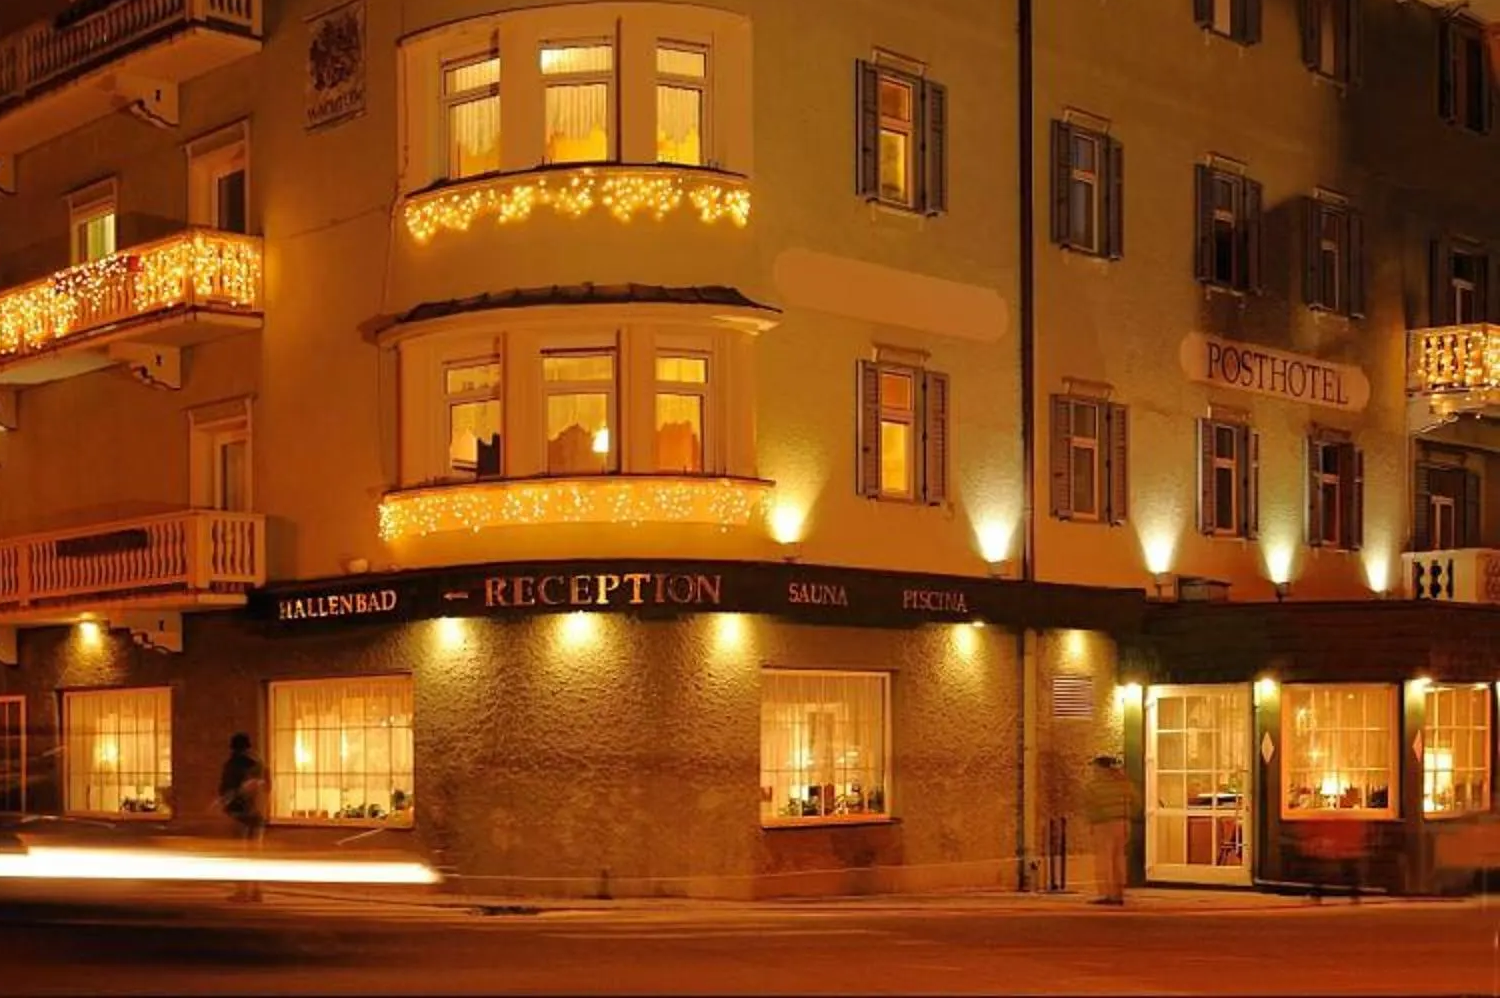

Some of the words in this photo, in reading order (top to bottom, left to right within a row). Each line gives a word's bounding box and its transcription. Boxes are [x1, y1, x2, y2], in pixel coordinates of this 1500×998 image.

[1206, 342, 1349, 405] POSTHOTEL
[279, 589, 398, 620] HALLENBAD
[484, 573, 722, 607] RECEPTION
[788, 582, 849, 607] SAUNA
[902, 589, 968, 613] PISCINA
